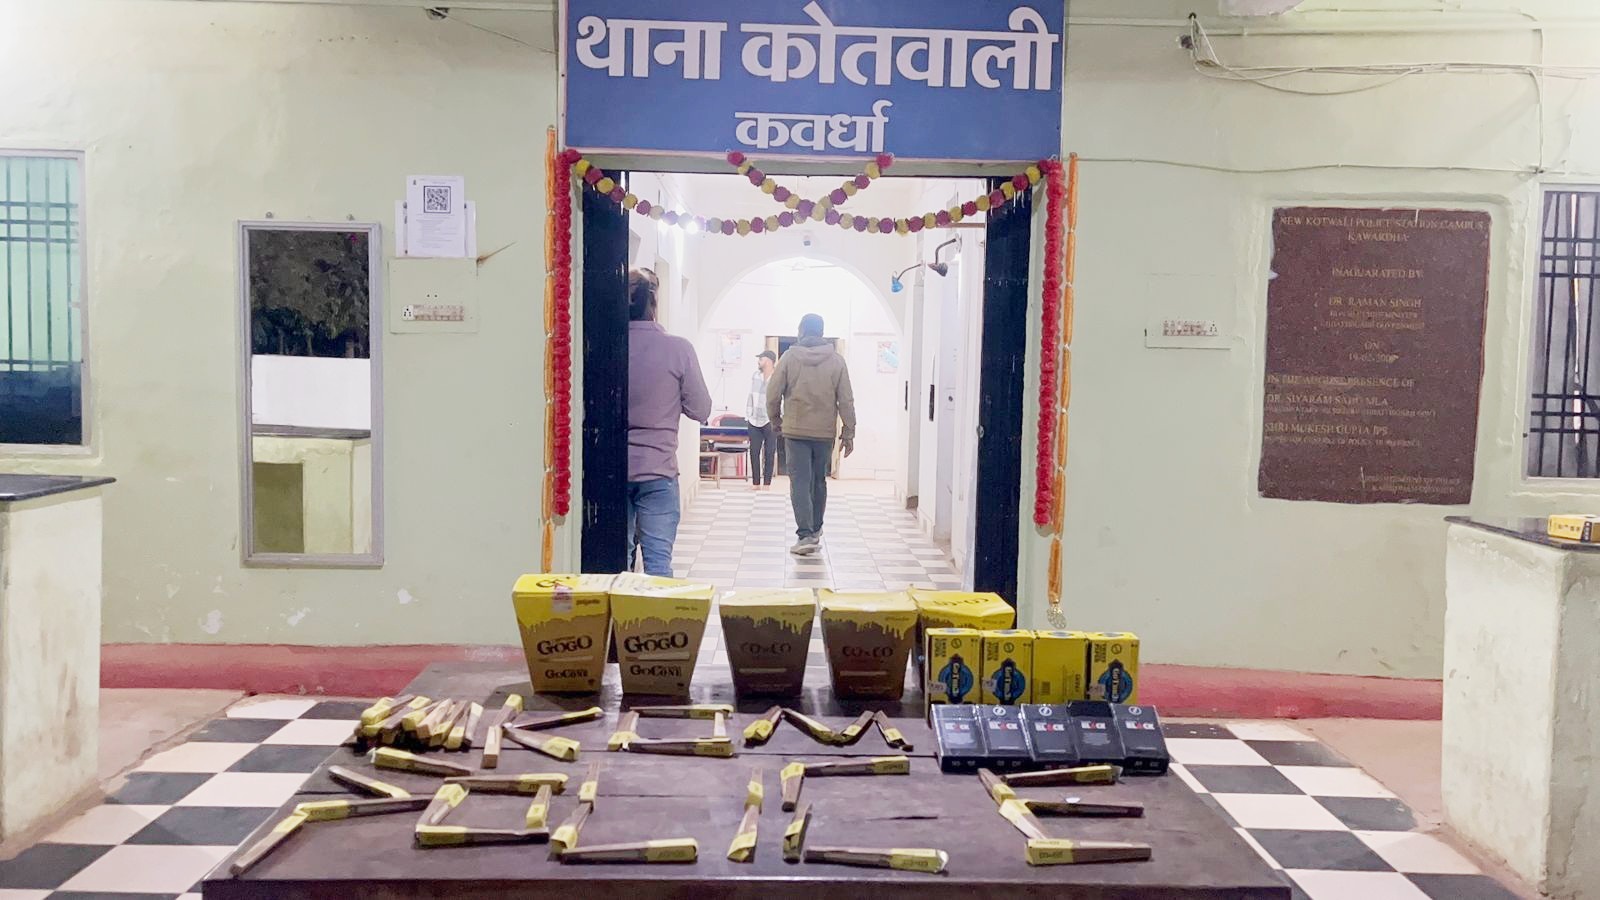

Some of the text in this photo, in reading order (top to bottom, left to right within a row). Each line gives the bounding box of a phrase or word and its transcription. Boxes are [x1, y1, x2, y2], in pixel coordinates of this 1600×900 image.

[575, 1, 1058, 90] थाना कोतवाली
[734, 100, 893, 153] कवर्धा
